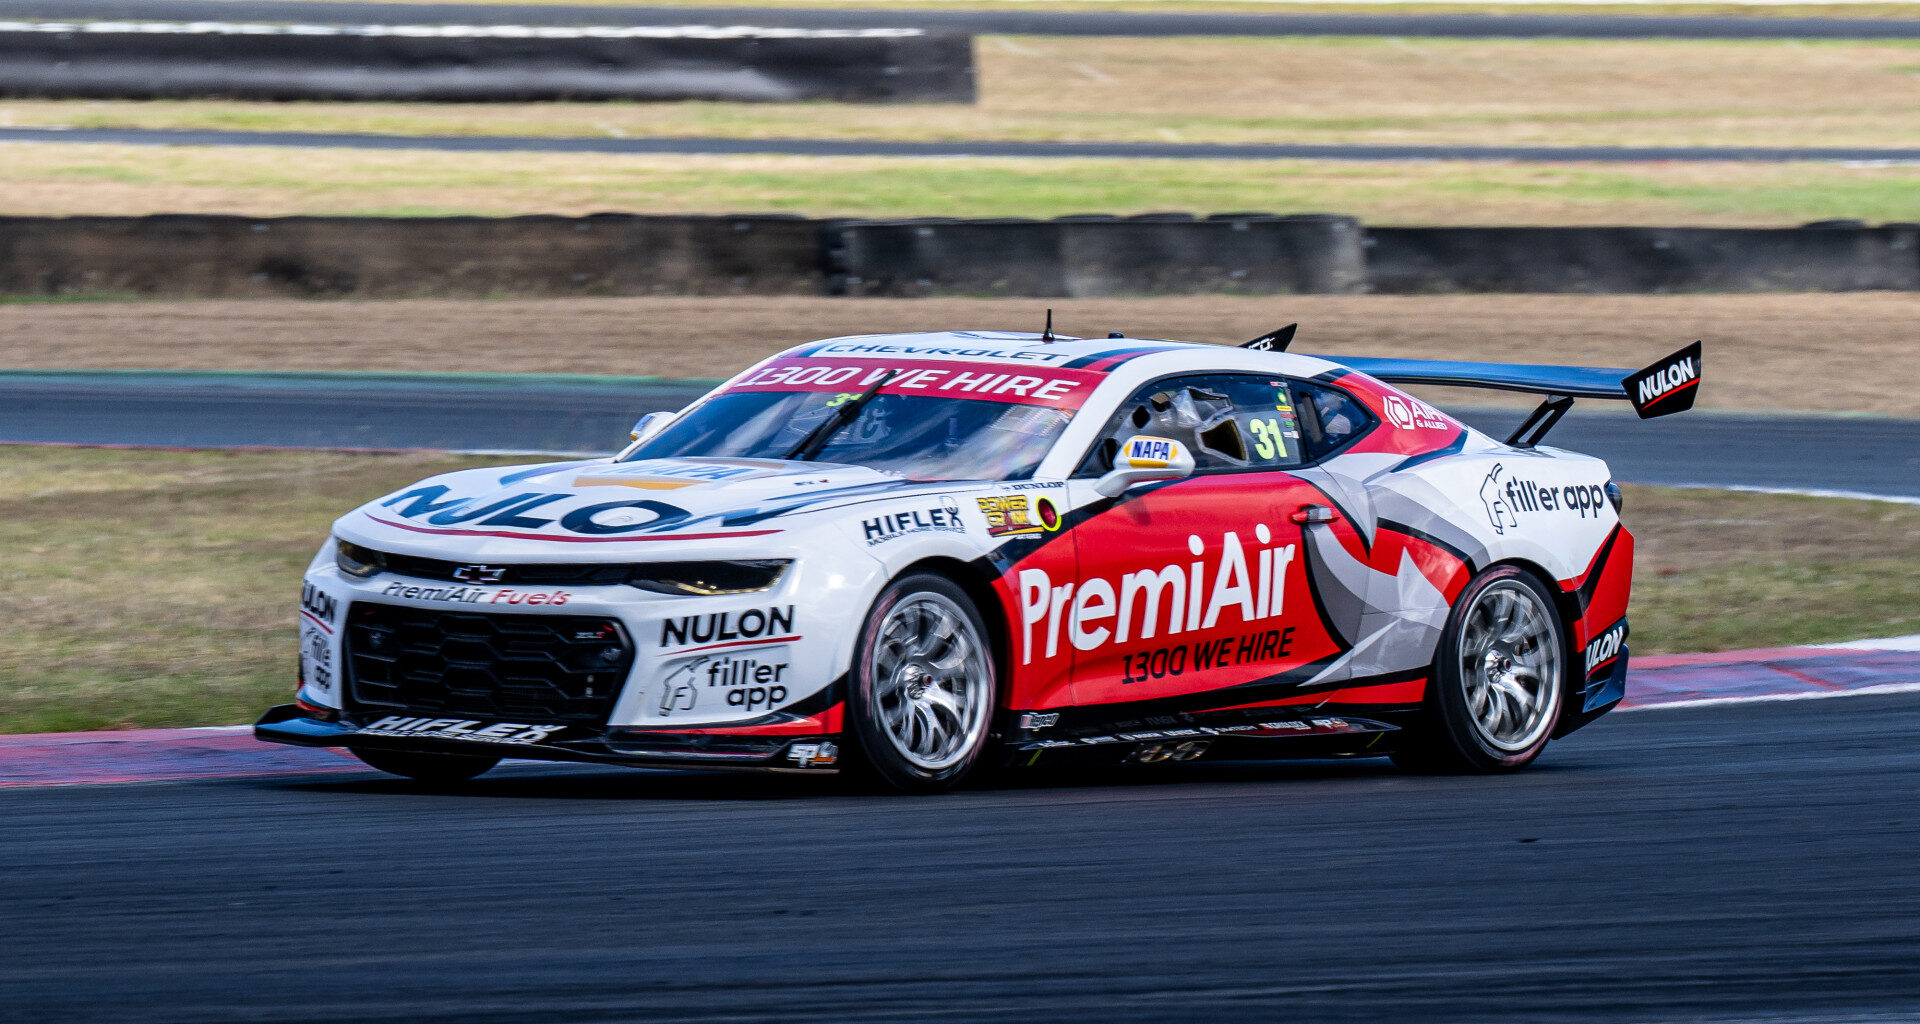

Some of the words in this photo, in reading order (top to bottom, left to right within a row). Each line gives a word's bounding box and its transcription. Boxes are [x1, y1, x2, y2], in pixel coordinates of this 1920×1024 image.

[826, 344, 1072, 361] CHEVROLET
[733, 366, 862, 388] 1300
[858, 367, 941, 390] WE
[942, 371, 1082, 401] HIRE
[1637, 356, 1696, 404] NULON
[1131, 440, 1171, 461] NAPA
[1250, 418, 1288, 460] 31
[1012, 481, 1065, 491] DUNLOP
[1506, 476, 1560, 512] fill'er
[1563, 484, 1605, 519] app
[381, 484, 814, 535] NULON
[861, 505, 964, 541] HIFLEX
[302, 579, 338, 625] ULON
[382, 581, 488, 604] PremiAir
[488, 589, 571, 606] Fuels
[1019, 523, 1296, 666] PremiAir
[659, 604, 795, 648] NULON
[1121, 644, 1190, 685] 1300
[1193, 636, 1235, 672] WE
[1235, 626, 1296, 665] HIRE
[1585, 625, 1624, 672] ULON
[707, 656, 789, 687] fill'er
[727, 684, 788, 712] app
[367, 715, 569, 741] HIFLEX
